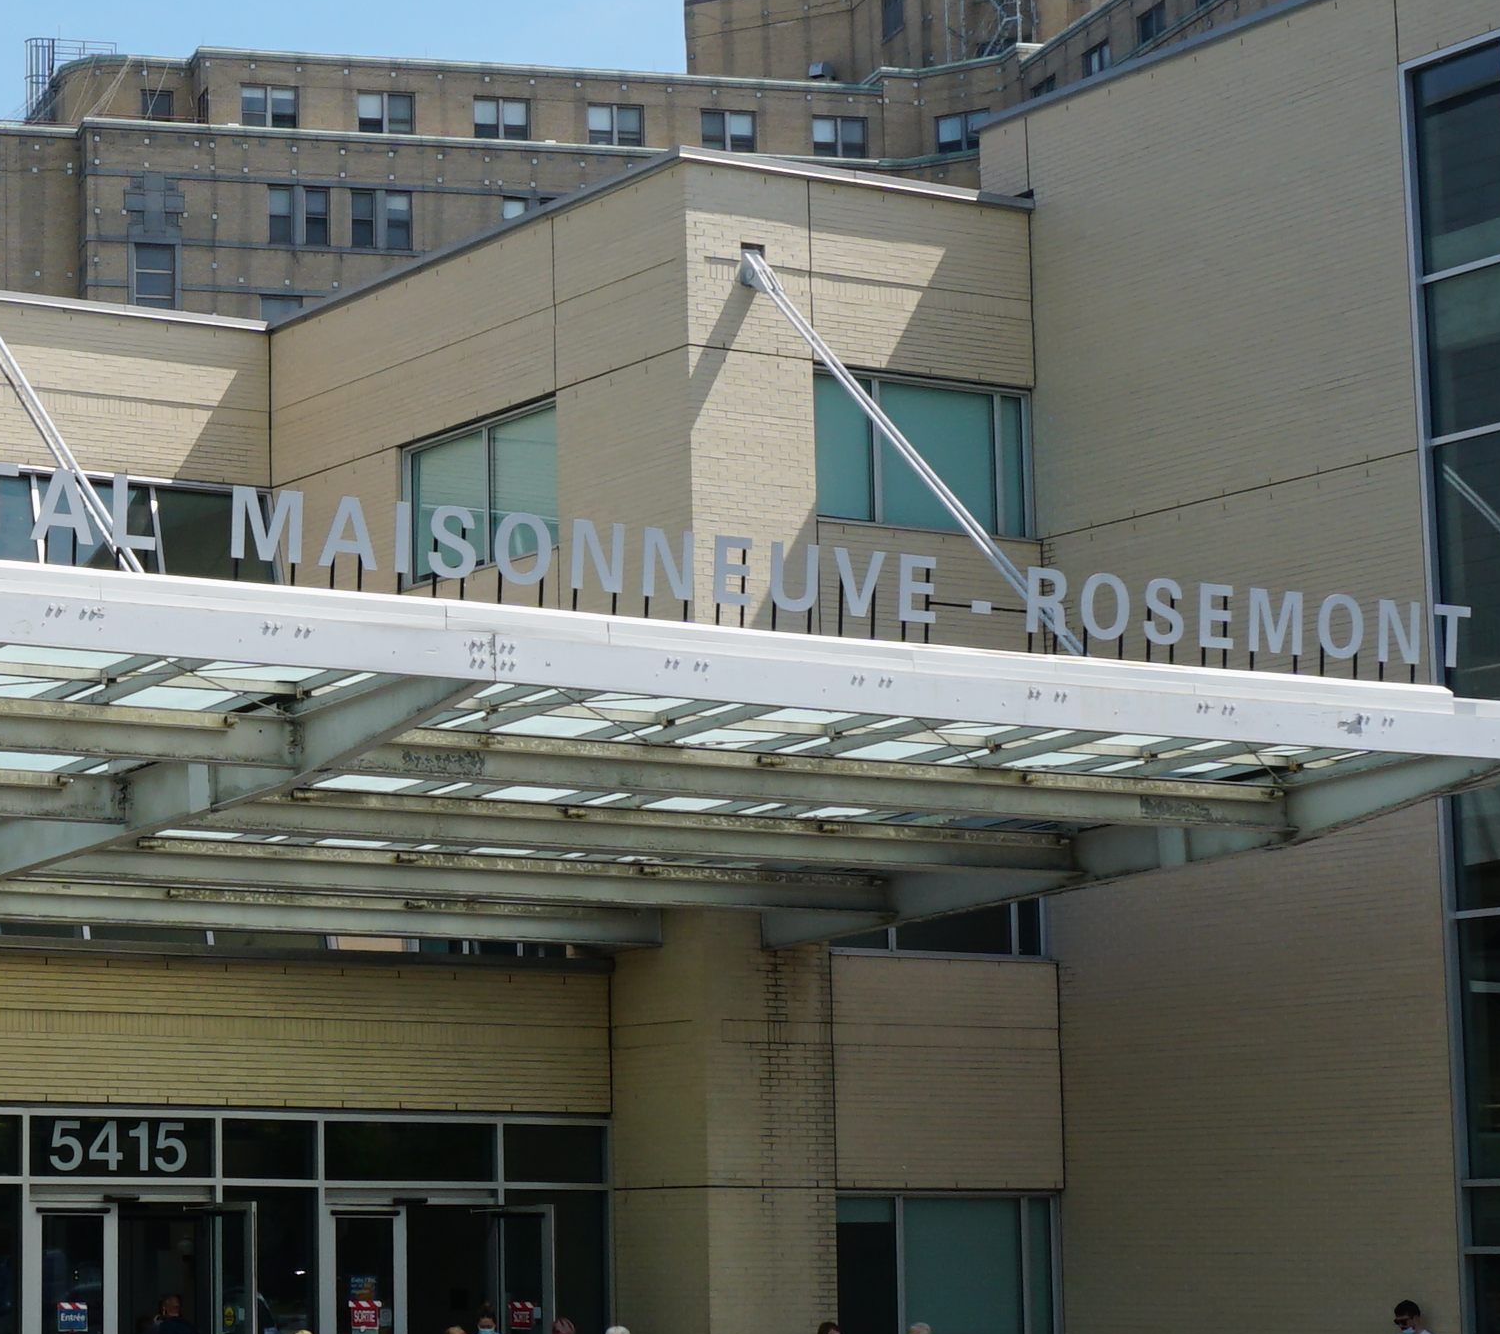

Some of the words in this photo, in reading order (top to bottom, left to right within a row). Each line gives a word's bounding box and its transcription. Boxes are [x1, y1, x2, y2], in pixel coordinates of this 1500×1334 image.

[228, 484, 939, 626] MAISONNEUVE
[1025, 565, 1473, 670] ROSEMONT
[48, 1120, 188, 1174] 5415
[60, 1312, 86, 1323] Entrée
[353, 1309, 376, 1323] SORTIE
